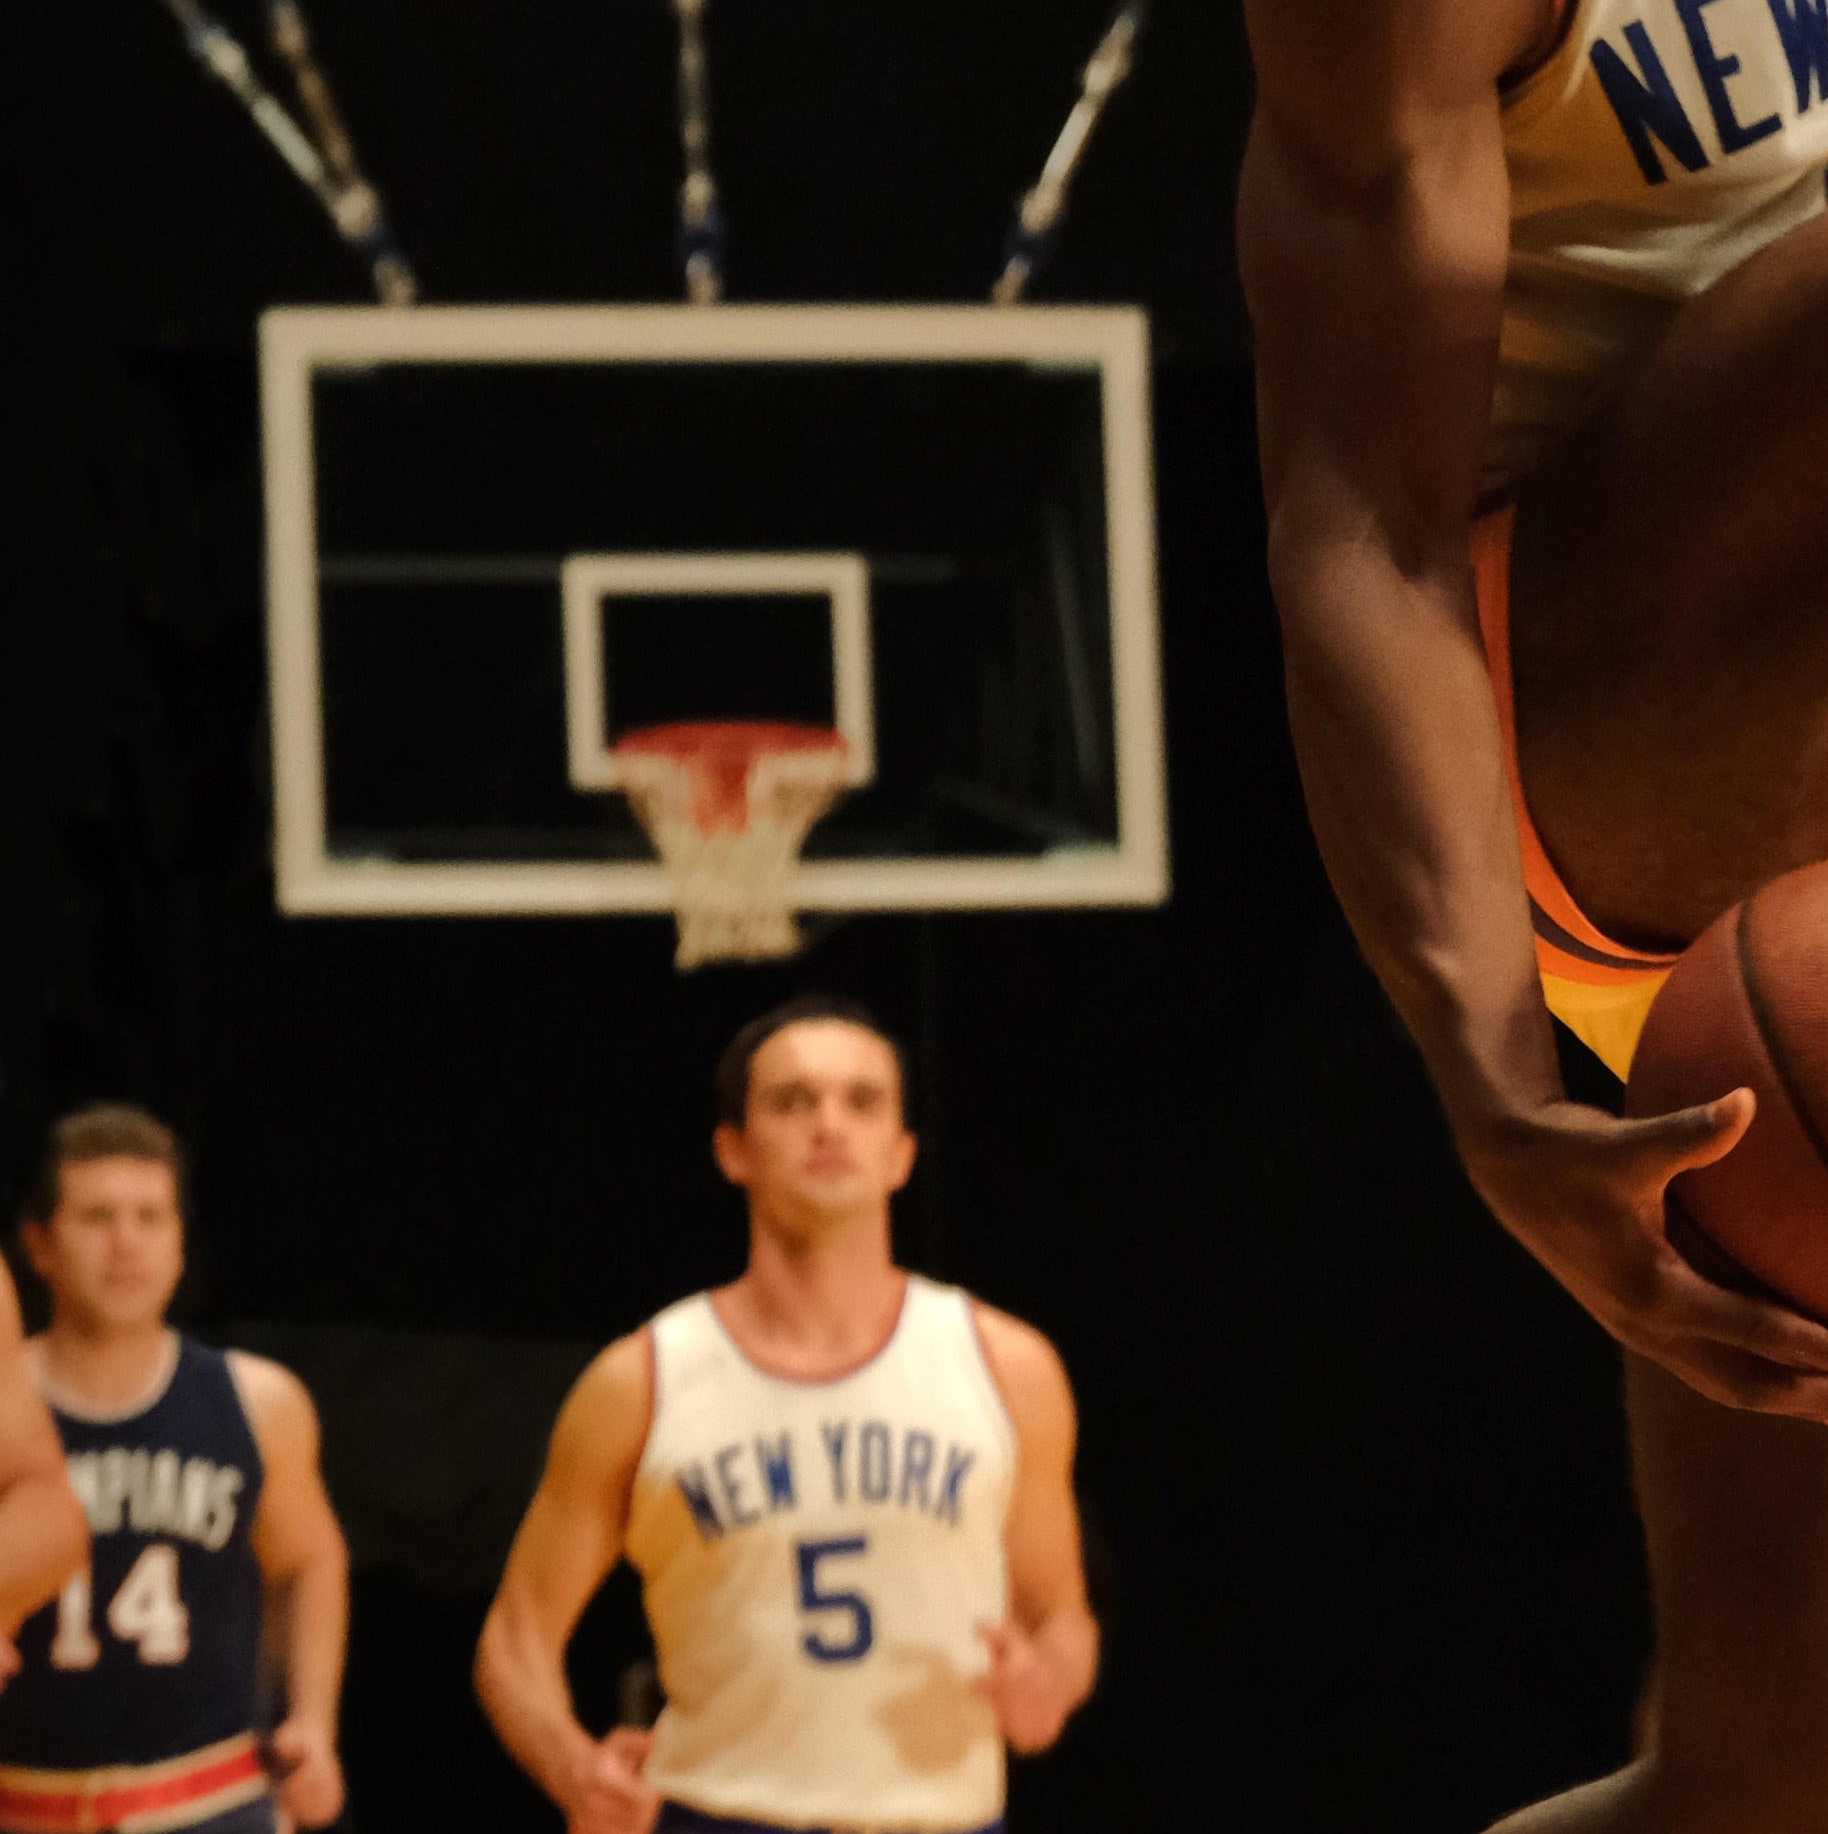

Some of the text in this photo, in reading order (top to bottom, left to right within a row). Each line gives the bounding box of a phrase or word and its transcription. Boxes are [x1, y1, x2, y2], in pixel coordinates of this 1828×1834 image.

[67, 1445, 244, 1553] MPIANS
[675, 1418, 977, 1540] NEW YORK
[50, 1542, 191, 1670] 14
[794, 1530, 875, 1663] 5
